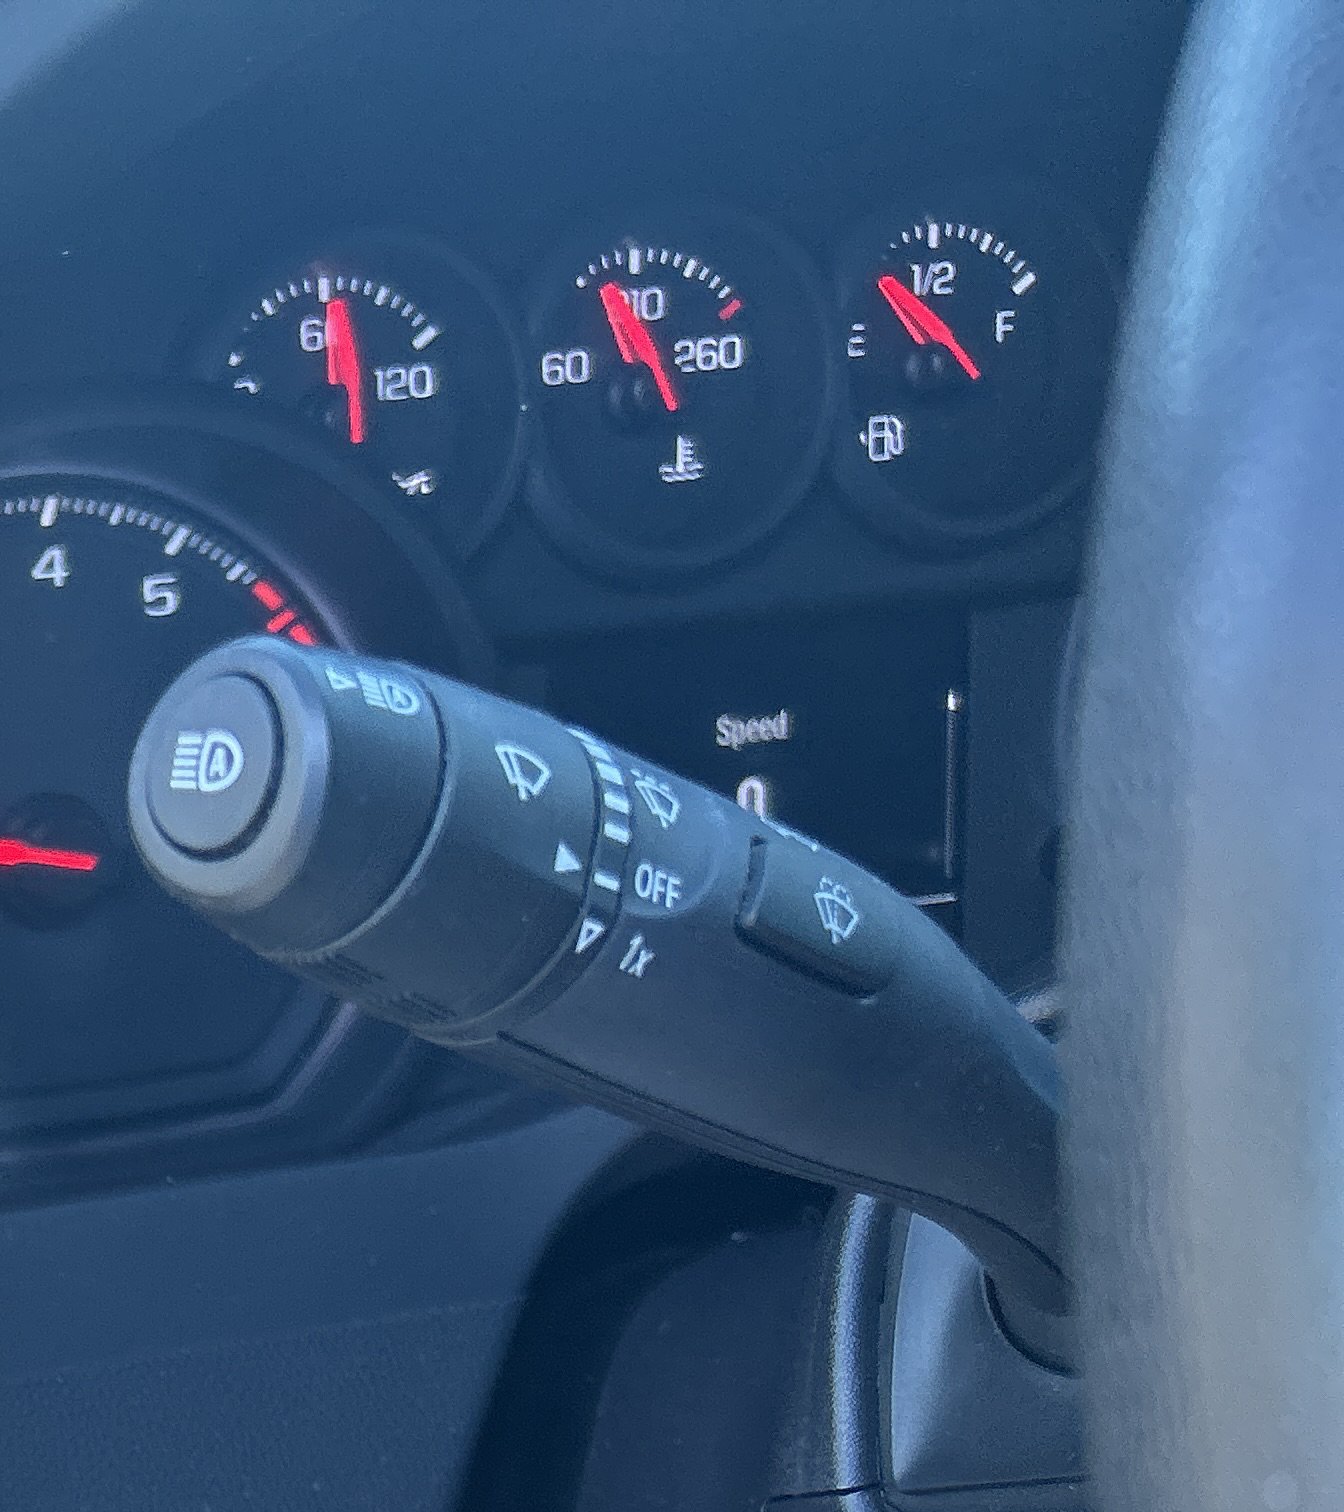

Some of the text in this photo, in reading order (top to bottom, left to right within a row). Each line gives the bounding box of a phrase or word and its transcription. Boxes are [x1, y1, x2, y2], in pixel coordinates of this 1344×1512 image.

[616, 287, 664, 322] 10
[995, 309, 1016, 344] F
[541, 348, 591, 387] 60
[673, 334, 744, 373] 260
[374, 364, 436, 402] 120
[30, 544, 70, 588] 4
[141, 572, 180, 618] 5
[714, 708, 790, 751] Speed
[634, 862, 682, 909] OFF
[618, 934, 657, 979] 1x
